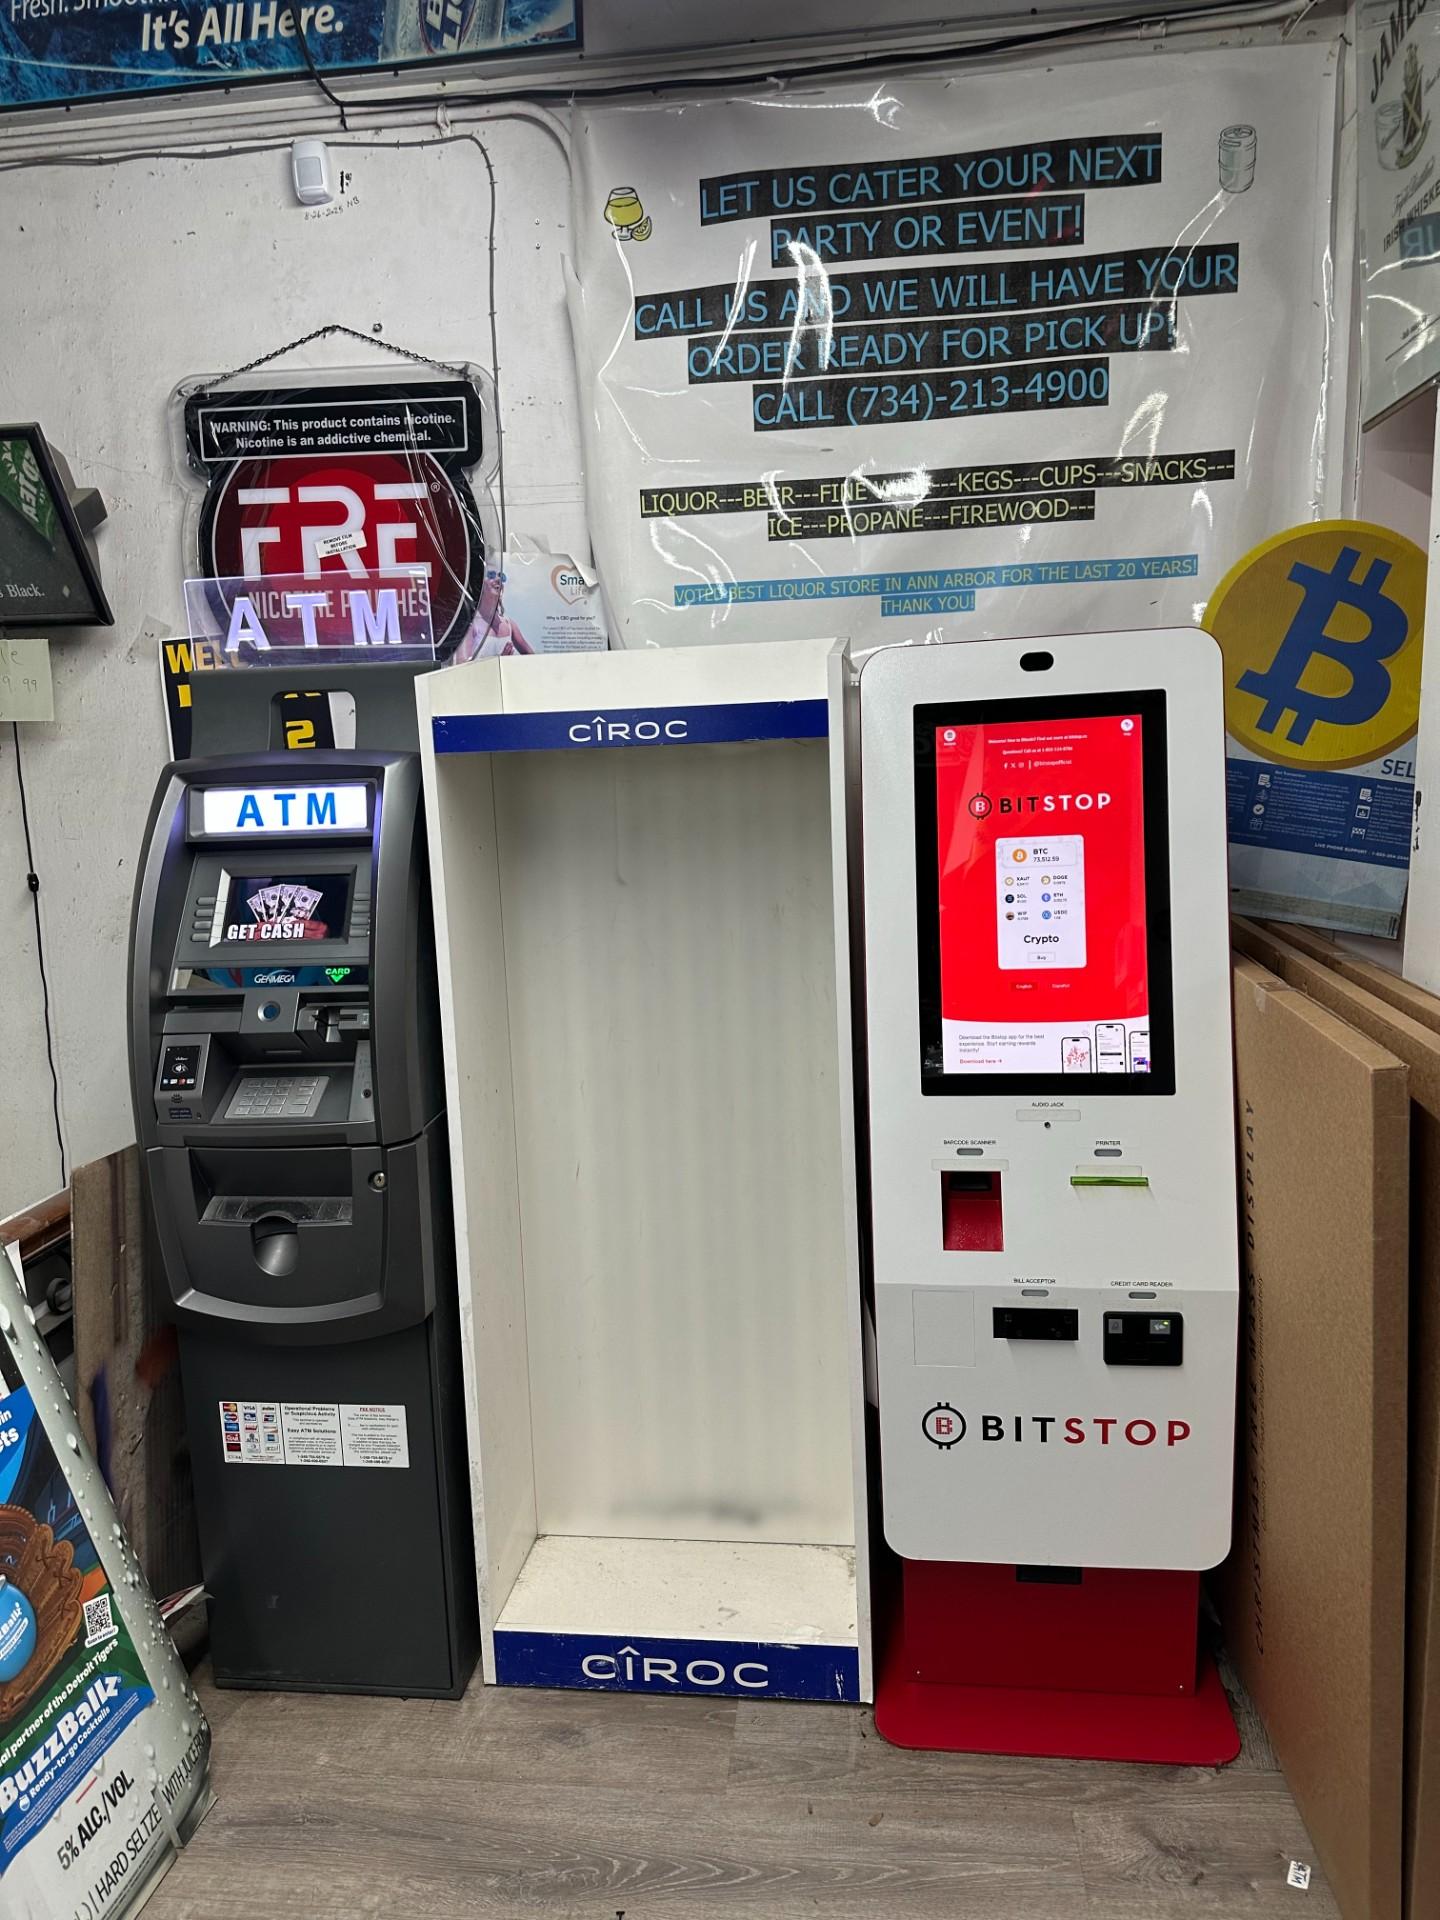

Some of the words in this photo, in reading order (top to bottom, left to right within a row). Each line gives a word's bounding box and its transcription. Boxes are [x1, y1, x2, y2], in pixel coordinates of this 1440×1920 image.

[142, 10, 189, 51] It's
[197, 2, 244, 46] All
[250, 1, 344, 40] Here.
[701, 180, 760, 219] LET
[772, 175, 817, 209] US
[829, 165, 943, 204] CATER
[954, 151, 1055, 192] YOUR
[1069, 143, 1162, 183] NEXT
[772, 219, 882, 261] PARTY
[893, 215, 945, 251] OR
[958, 204, 1081, 246] EVENT!
[635, 297, 713, 335] CALL
[724, 289, 768, 324] US
[779, 284, 851, 321] AND
[863, 278, 919, 313] WE
[930, 271, 1018, 310] WILL
[1031, 260, 1125, 303] HAVE
[1136, 253, 1238, 291] YOUR
[689, 341, 807, 378] ORDER
[817, 330, 930, 370] READY
[942, 325, 1013, 361] FOR
[1025, 314, 1106, 353] PICK
[754, 388, 835, 426] CALL
[845, 366, 1110, 427] (734)-213-4900
[211, 418, 272, 434] WARNING:
[273, 417, 299, 431] This
[301, 415, 347, 430] product
[349, 413, 401, 428] contains
[403, 411, 456, 427] nicotine.
[235, 434, 285, 449] Nicotine
[286, 434, 298, 447] is
[300, 435, 315, 446] an
[317, 431, 371, 446] addictive
[373, 428, 432, 444] chemical.
[238, 482, 433, 582] FRE
[5, 583, 46, 598] Black.
[730, 584, 765, 600] BEST
[768, 580, 827, 599] LIQUOR
[830, 578, 880, 595] STORE
[885, 576, 902, 591] IN
[907, 574, 939, 590] ANN
[943, 569, 997, 588] ARBOR
[1001, 567, 1033, 584] FOR
[1038, 565, 1069, 581] THE
[1075, 563, 1112, 580] LAST
[1118, 561, 1137, 578] 20
[1141, 557, 1199, 576] YEARS!
[882, 596, 933, 614] THANK
[939, 592, 975, 610] YOU!
[225, 589, 401, 652] ATM
[569, 715, 688, 743] CÎROC
[237, 792, 337, 828] ATM
[1000, 793, 1111, 816] BITSTOP
[227, 923, 259, 940] GET
[261, 923, 305, 940] CASH
[1023, 934, 1060, 945] Crypto
[325, 967, 351, 975] CARD
[1246, 1100, 1255, 1250] DISPLAY
[982, 1414, 1191, 1447] BITSTOP
[581, 1645, 769, 1689] CÎROC
[11, 1715, 44, 1758] partner
[44, 1703, 55, 1719] of
[53, 1690, 68, 1707] the
[66, 1660, 96, 1695] Detroit
[92, 1638, 119, 1667] Tigers
[0, 1676, 119, 1814] BuzzBallz
[29, 1742, 79, 1798] Ready-to-go
[77, 1706, 111, 1745] Cocktails
[57, 1834, 80, 1870] 5%
[76, 1770, 135, 1849] ALC./VOL.
[95, 1850, 130, 1903] HARD
[161, 1766, 186, 1805] WITH
